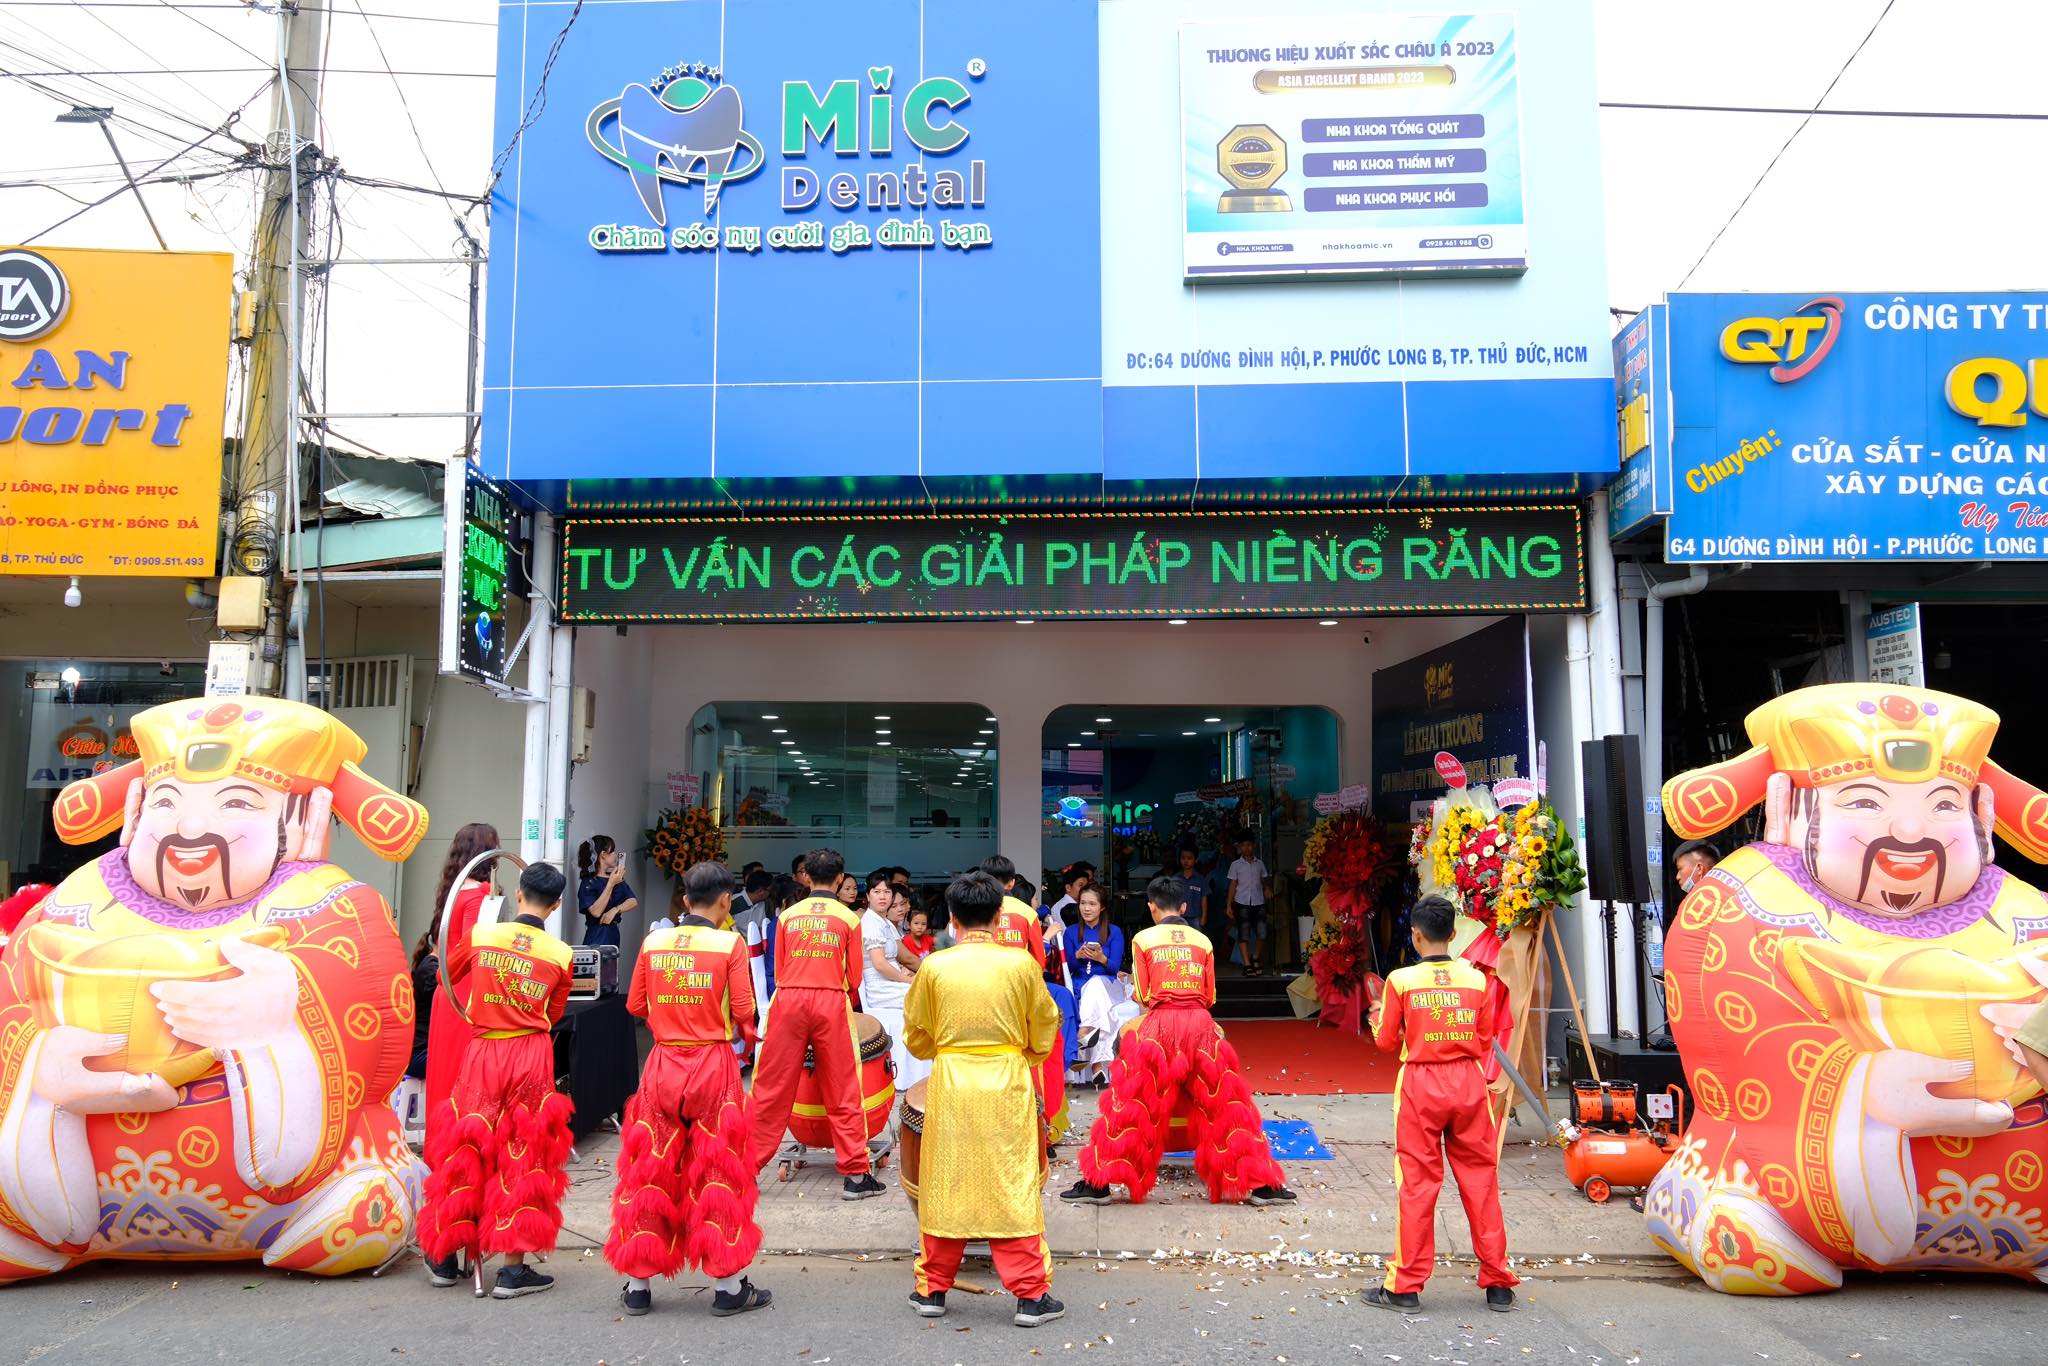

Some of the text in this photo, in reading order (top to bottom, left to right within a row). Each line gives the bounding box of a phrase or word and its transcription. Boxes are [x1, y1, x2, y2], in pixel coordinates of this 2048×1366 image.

[1276, 44, 1309, 64] HIỆU
[1314, 41, 1356, 61] XUẤT
[1361, 40, 1390, 59] SẮC
[1395, 41, 1436, 58] CHÂU
[1441, 40, 1451, 56] Á
[1457, 42, 1495, 56] 2023
[1278, 72, 1424, 87] ASIA EXCELLENT BRAND 2023
[1326, 120, 1459, 137] NHA KHOA TỔNG QUÁT
[1333, 154, 1455, 171] NHA KHOA THẨM MỸ
[781, 160, 986, 211] Dental
[1336, 194, 1360, 205] NHA
[1364, 193, 1397, 204] KHOA
[1401, 192, 1431, 206] PHỤC
[589, 218, 993, 255] Chăm sóc nụ cười gia đình bạn
[1322, 242, 1393, 250] nhakhoamic.vn
[1865, 297, 1958, 330] CÔNG
[1966, 304, 2012, 330] TY
[1720, 315, 1827, 364] QT
[1180, 349, 1231, 369] DƯƠNG
[1238, 349, 1274, 368] ĐÌNH
[1331, 345, 1382, 367] PHƯỚC
[1388, 348, 1427, 366] LONG
[1432, 348, 1447, 368] B,
[1451, 348, 1474, 365] TP.
[1478, 341, 1509, 365] THỦ
[1554, 345, 1588, 363] HCM
[12, 348, 132, 390] AN
[1792, 436, 1855, 464] CỬA
[1865, 435, 1924, 464] SẮT
[1951, 436, 2015, 464] CỬA
[61, 484, 79, 494] IN
[84, 480, 130, 495] ĐỒNG
[135, 485, 179, 499] PHỤC
[1826, 470, 1889, 495] XÂY
[1898, 474, 1984, 500] DỰNG
[474, 485, 501, 533] NHA
[25, 517, 69, 528] YOGA
[79, 518, 115, 528] GYM
[126, 516, 169, 529] BÓNG
[176, 516, 200, 529] ĐÁ
[15, 554, 31, 563] TP.
[35, 552, 56, 564] THỦ
[60, 553, 84, 564] ĐỨC
[468, 523, 506, 576] KHOA
[1671, 537, 1696, 555] 64
[1703, 534, 1770, 556] DƯƠNG
[1776, 535, 1824, 555] ĐÌNH
[1833, 534, 1869, 559] HỘI
[1984, 537, 2037, 554] LONG
[570, 546, 647, 590] TƯ
[662, 536, 771, 590] VẤN
[790, 534, 902, 589] CÁC
[921, 531, 1025, 586] GIẢI
[1045, 531, 1192, 585] PHÁP
[1403, 528, 1563, 580] RĂNG
[1869, 607, 1911, 629] AUSTEC
[520, 978, 549, 1001] ANH
[688, 971, 713, 989] ANH
[657, 994, 704, 1004] 0937.183.477
[1424, 1031, 1474, 1042] 0937.183.477
